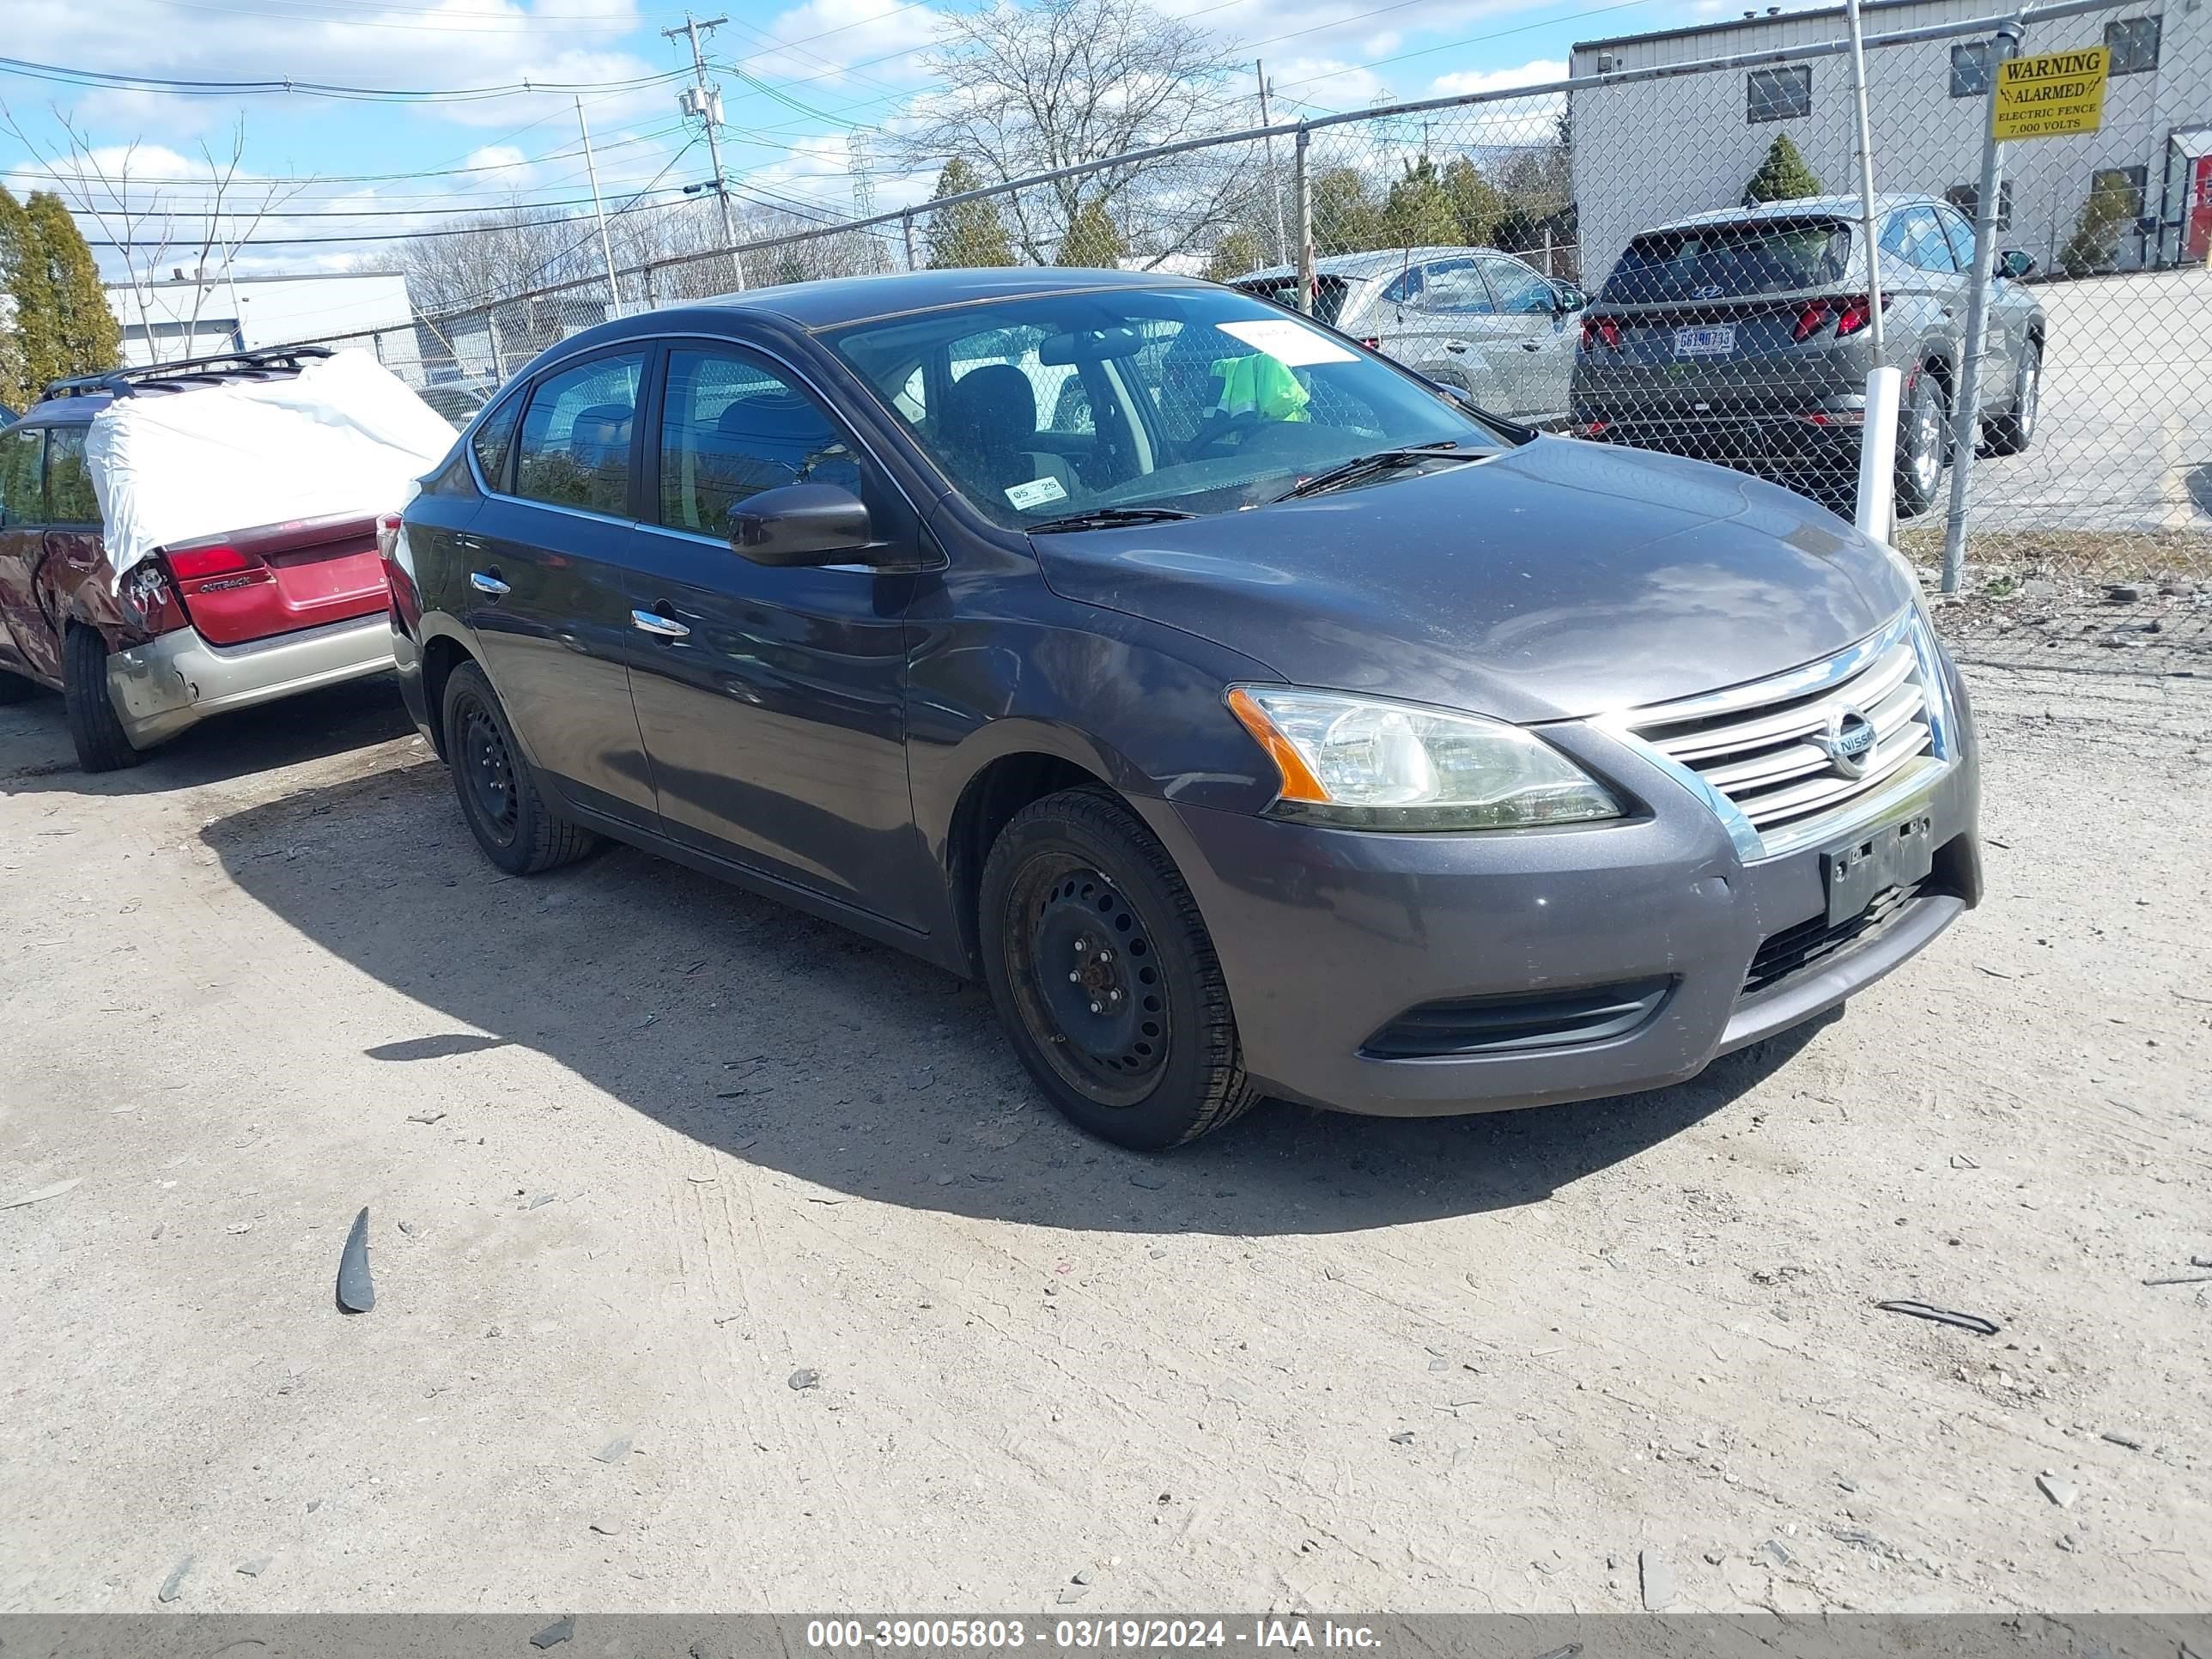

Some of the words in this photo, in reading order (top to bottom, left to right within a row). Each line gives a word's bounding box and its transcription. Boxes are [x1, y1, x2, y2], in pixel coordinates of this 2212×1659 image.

[2006, 52, 2101, 80] WARNING
[2014, 82, 2085, 104] ALARMED
[1998, 107, 2054, 122] ELECTRIC
[2057, 103, 2097, 116] FENCE
[2044, 118, 2081, 131] VOLTS
[1012, 489, 1029, 499] 05
[1041, 481, 1057, 490] 25
[200, 576, 252, 593] OUTBACK
[1840, 731, 1874, 752] NISSA
